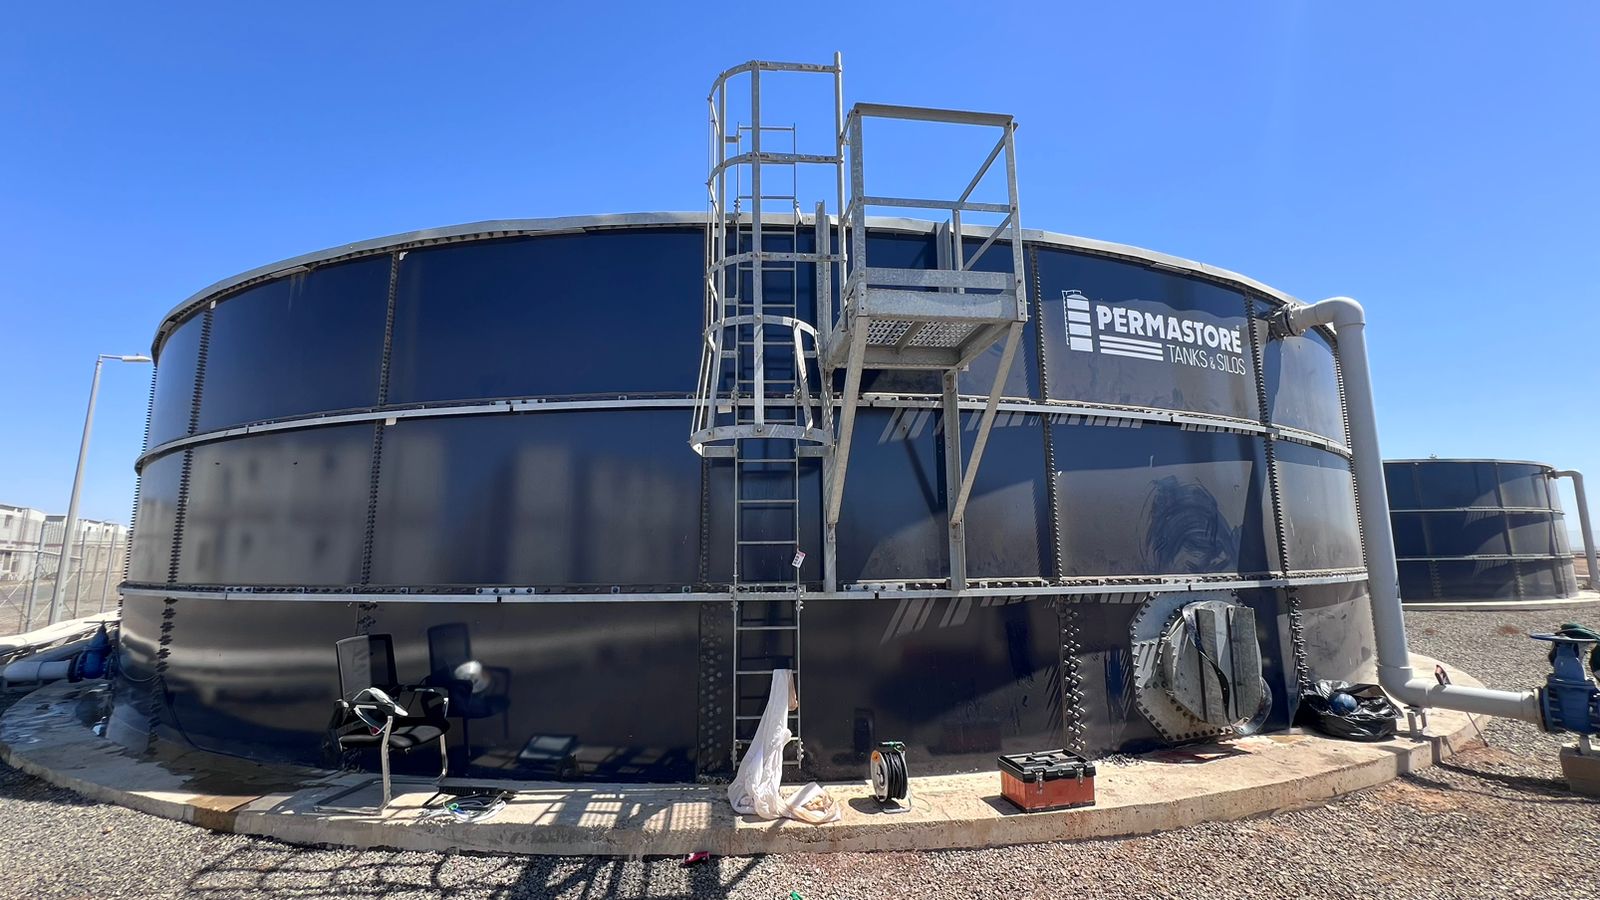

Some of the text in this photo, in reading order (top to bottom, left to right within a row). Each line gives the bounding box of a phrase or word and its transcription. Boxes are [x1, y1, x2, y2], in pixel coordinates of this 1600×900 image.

[1096, 305, 1242, 354] PERMASTORE
[1167, 345, 1246, 375] TANKS & SILOS
